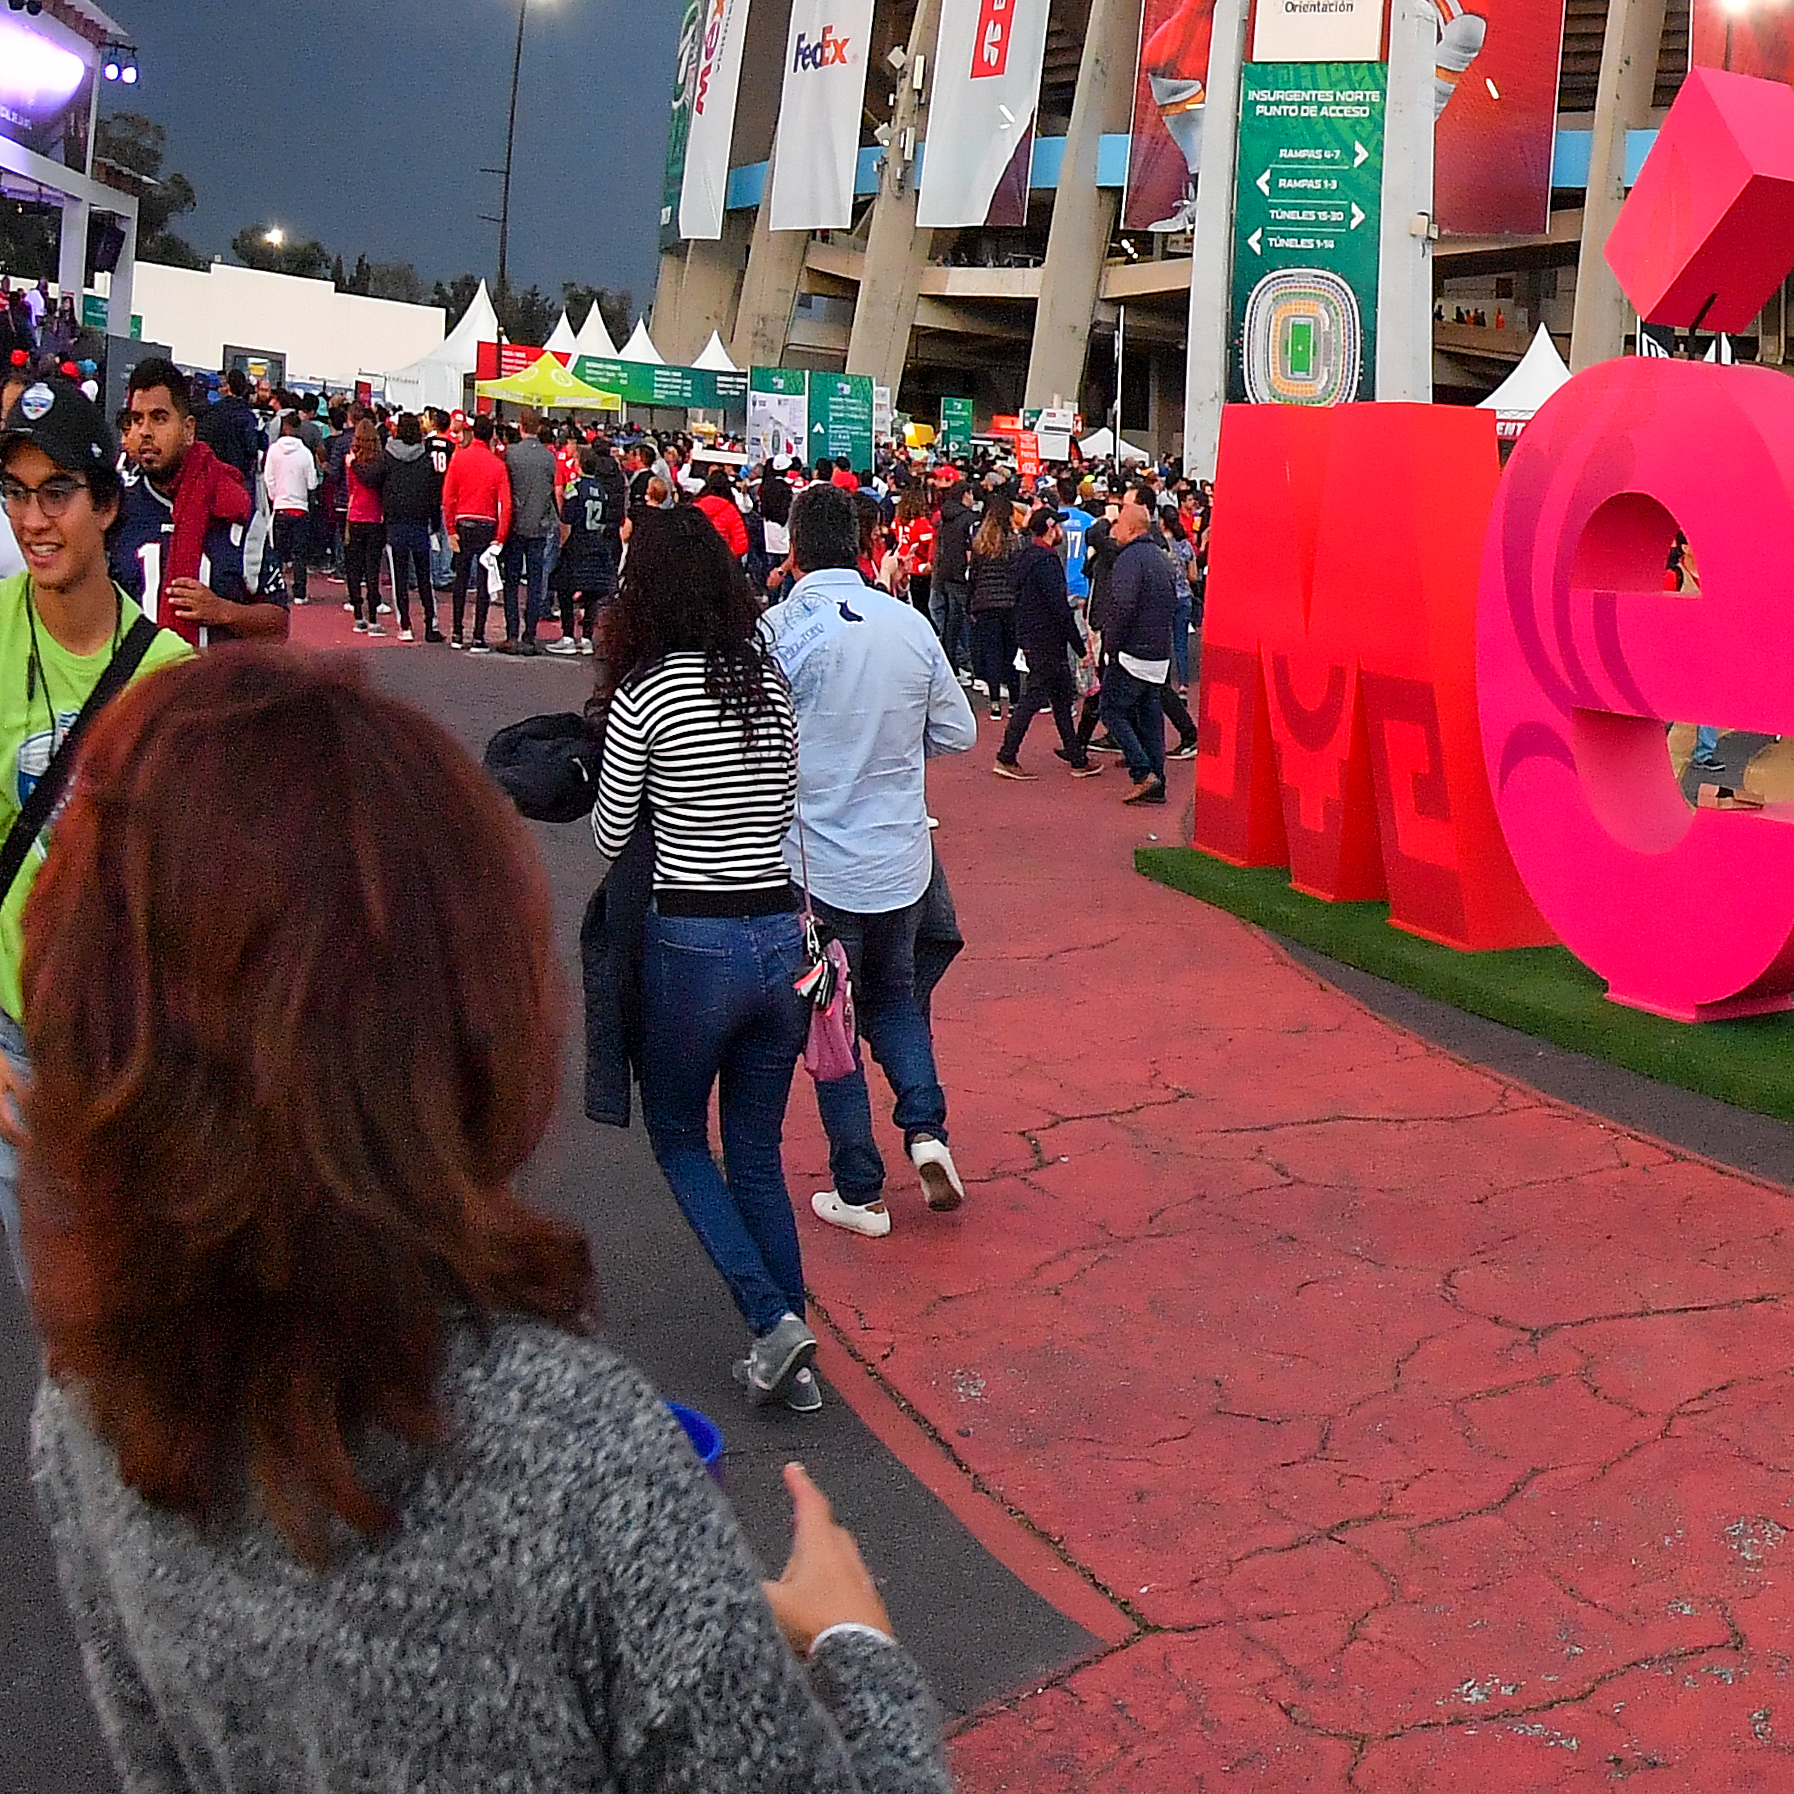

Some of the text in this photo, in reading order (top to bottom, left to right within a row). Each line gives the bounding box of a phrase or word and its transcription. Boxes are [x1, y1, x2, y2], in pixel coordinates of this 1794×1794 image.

[1284, 0, 1354, 13] Orientación
[793, 25, 850, 73] FedEx
[1248, 90, 1380, 102] INSURGENTES NORTE
[1256, 105, 1370, 117] PUNTO DE ACCESO
[1279, 148, 1341, 159] RAMPAS 4-7
[1278, 178, 1322, 189] RAMPAS
[1269, 208, 1315, 221] TÚNELES
[1267, 236, 1314, 248] TÚNELES
[430, 450, 447, 473] 18
